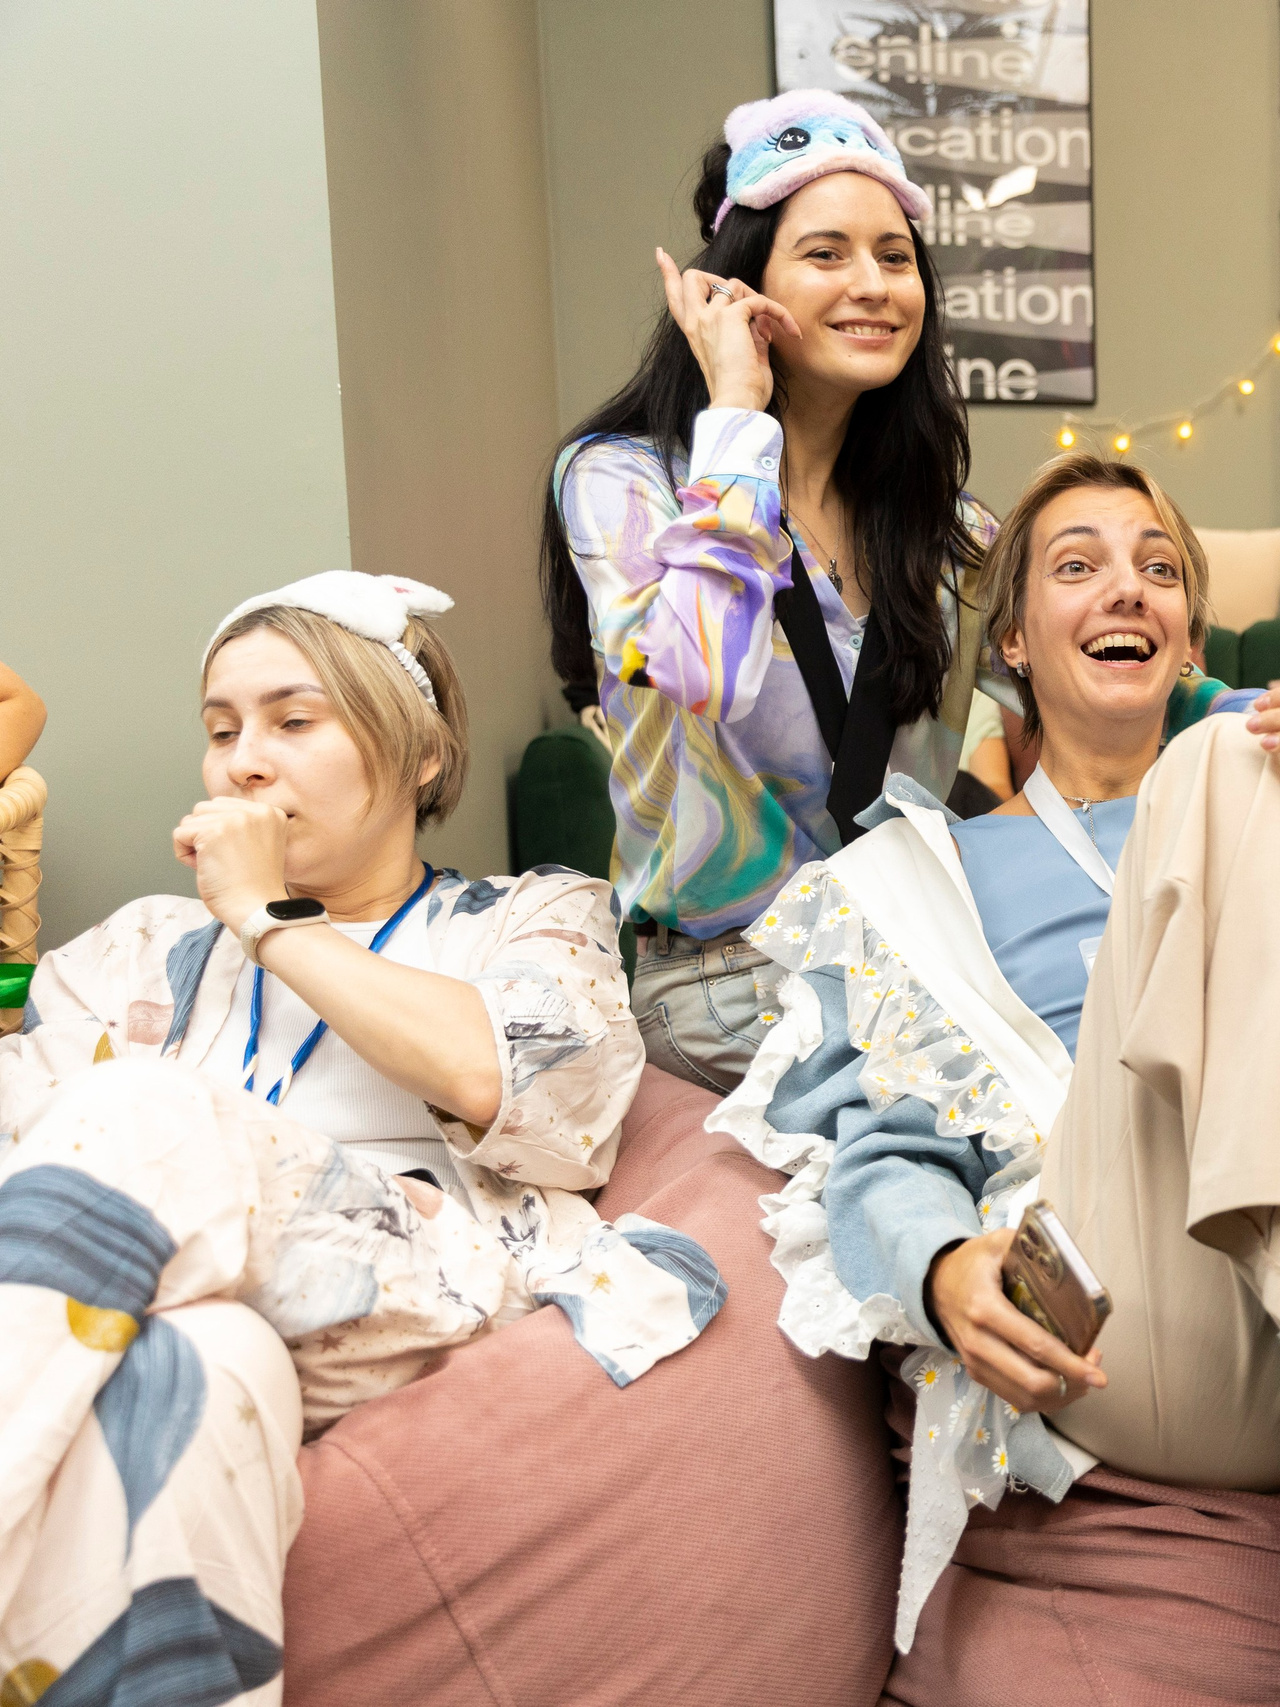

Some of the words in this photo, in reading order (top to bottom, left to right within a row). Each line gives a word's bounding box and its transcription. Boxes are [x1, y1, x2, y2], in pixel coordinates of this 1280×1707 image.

[888, 107, 1089, 168] cation
[918, 183, 1035, 249] line
[944, 266, 1092, 325] ation
